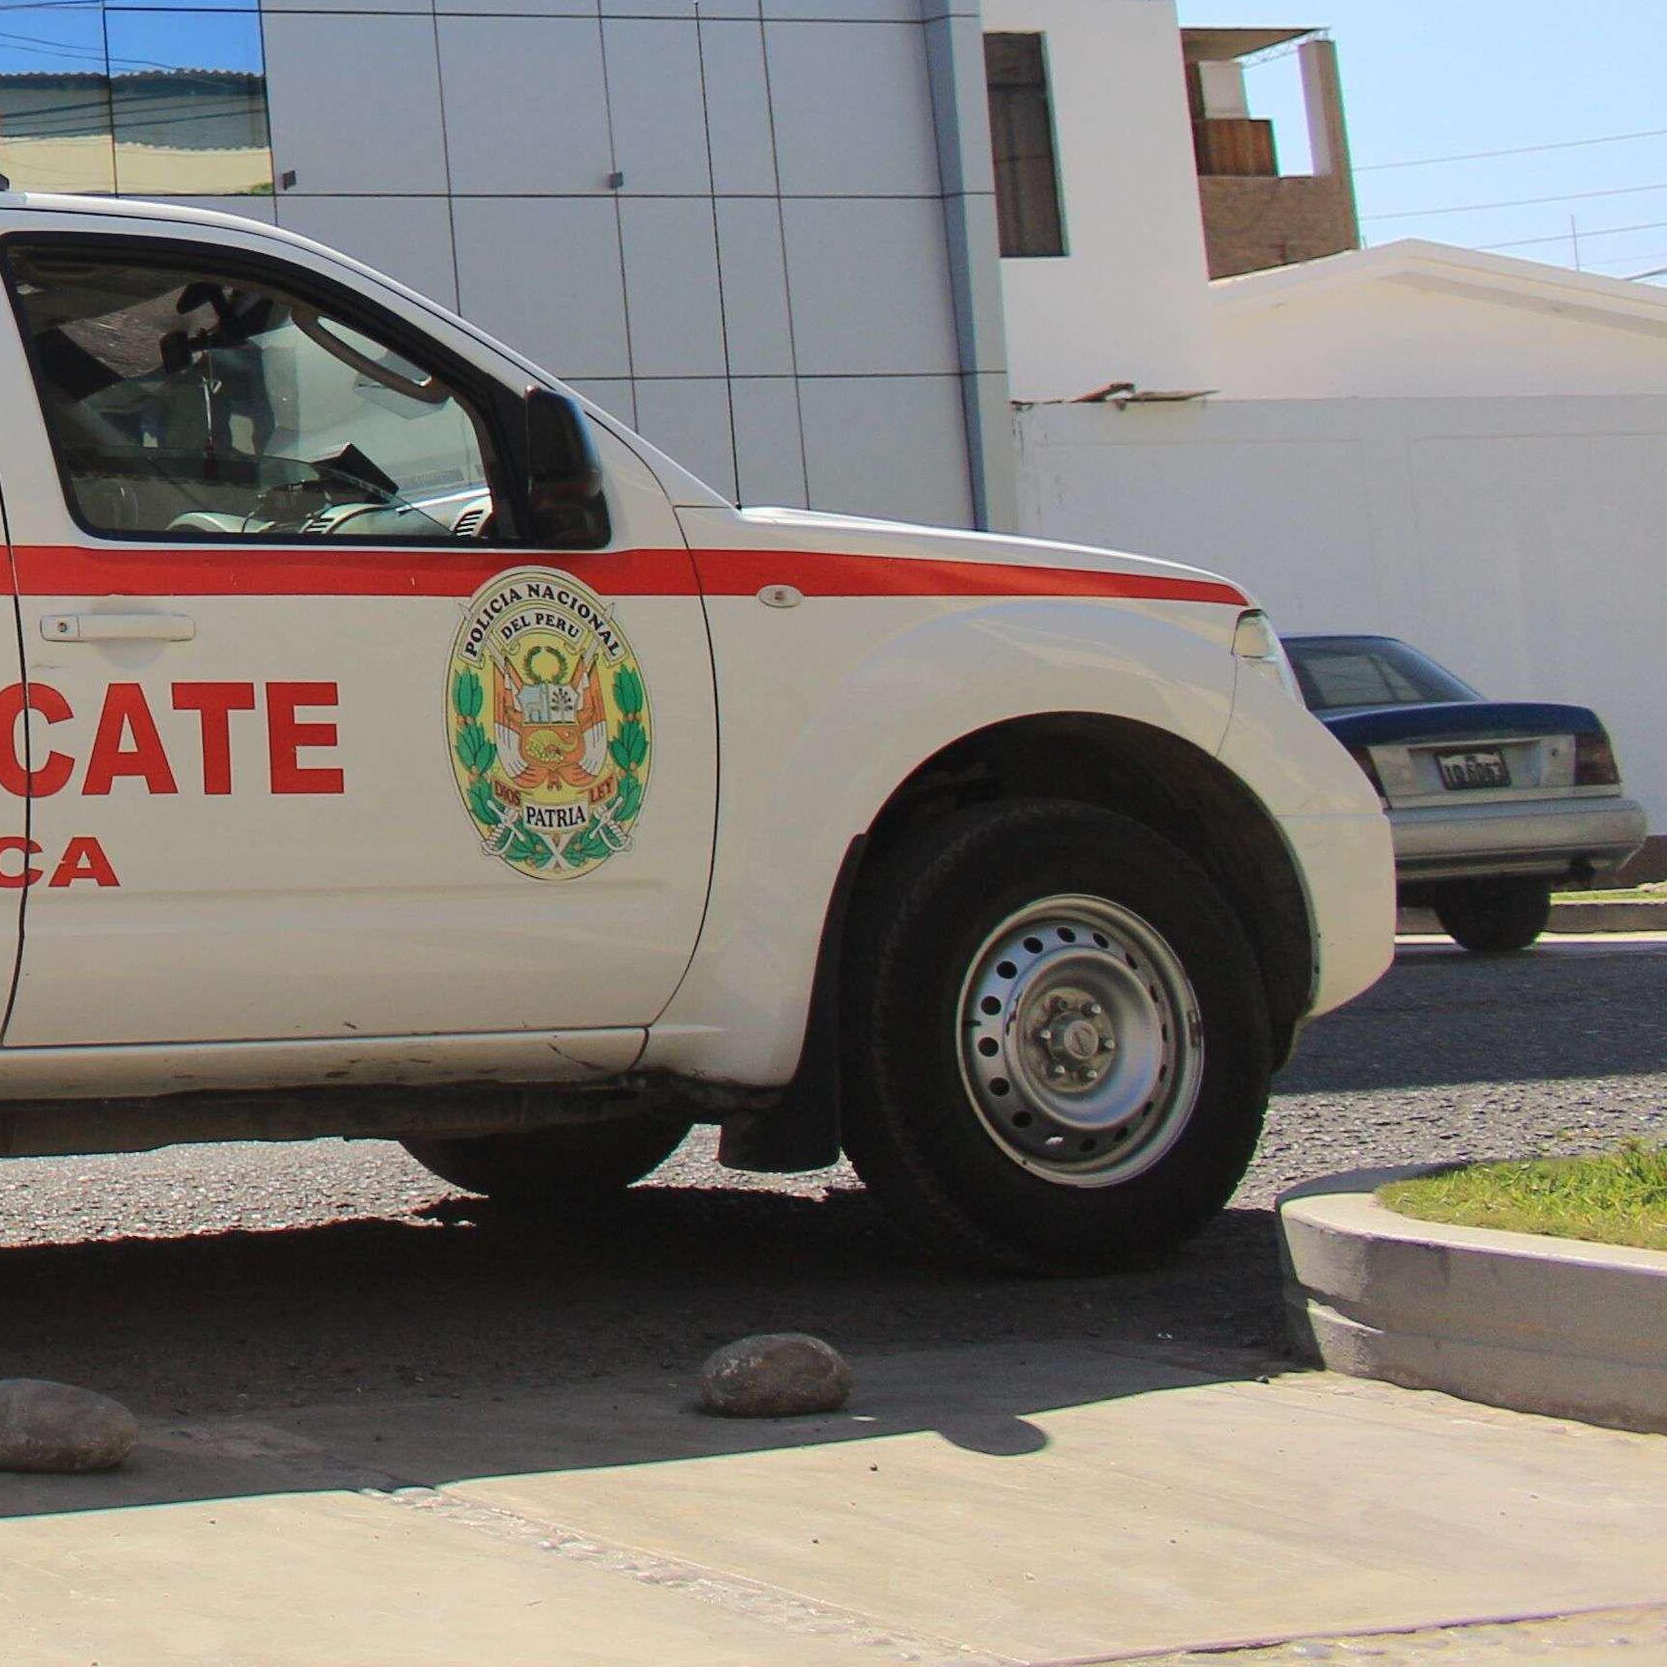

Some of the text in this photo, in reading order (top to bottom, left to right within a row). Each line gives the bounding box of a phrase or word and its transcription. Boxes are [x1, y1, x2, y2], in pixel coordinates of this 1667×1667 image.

[465, 583, 623, 658] POLICIA NACIONAL
[501, 612, 580, 641] DEL PERU
[525, 805, 586, 828] PATRIA
